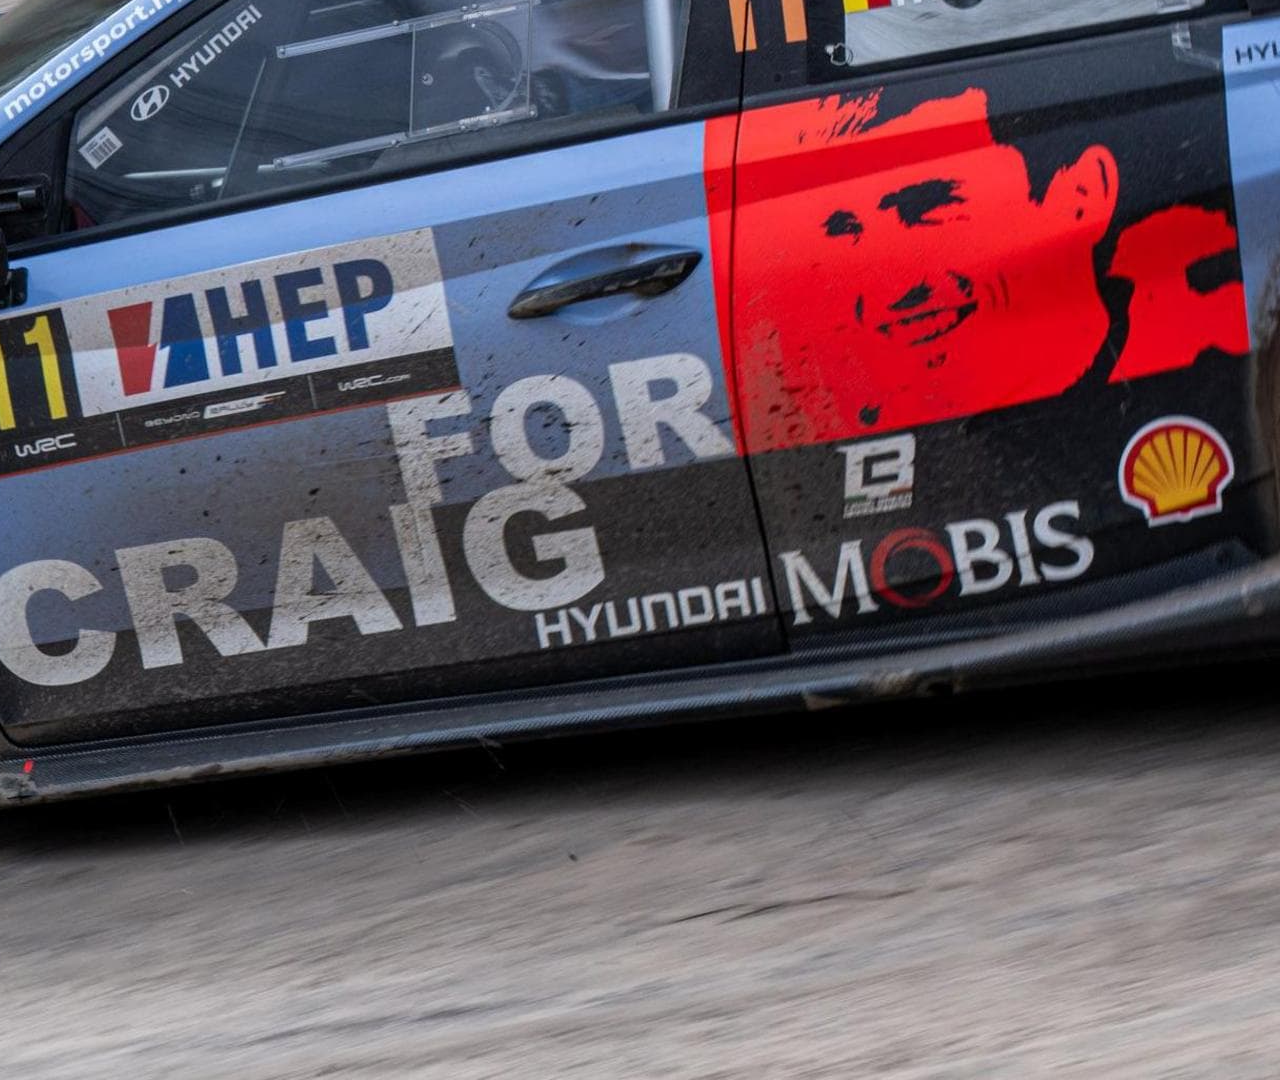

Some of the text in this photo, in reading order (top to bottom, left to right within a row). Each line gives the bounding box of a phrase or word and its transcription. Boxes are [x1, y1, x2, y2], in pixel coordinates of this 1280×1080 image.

[169, 4, 263, 88] HYUNDAI
[15, 433, 77, 458] WRC
[387, 352, 738, 511] FOR
[779, 500, 1095, 627] MOBIS
[535, 575, 767, 649] HYUNDAI
